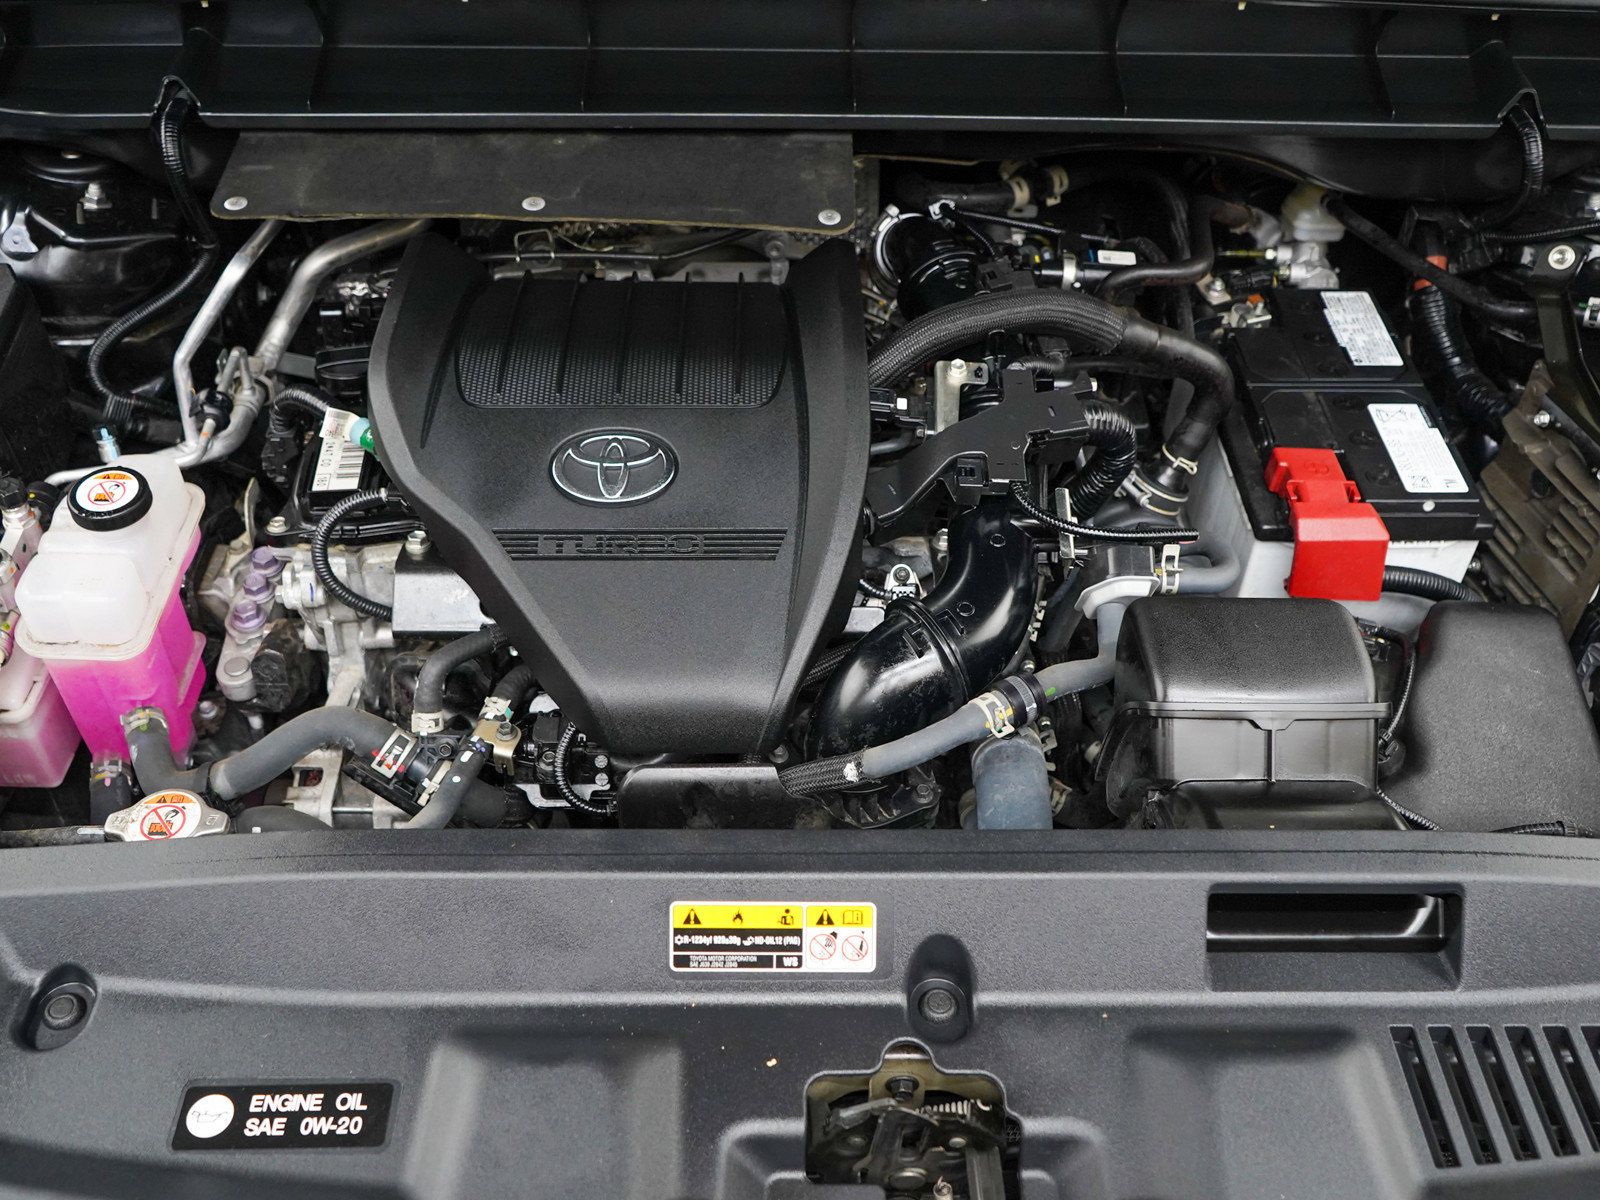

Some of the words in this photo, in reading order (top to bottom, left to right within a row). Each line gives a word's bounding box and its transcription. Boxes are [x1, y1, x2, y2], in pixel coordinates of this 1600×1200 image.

[543, 534, 700, 555] TURBO
[249, 1093, 324, 1112] ENGINE
[335, 1092, 368, 1111] OIL
[243, 1117, 288, 1137] SAE
[300, 1116, 363, 1136] 0W-20
